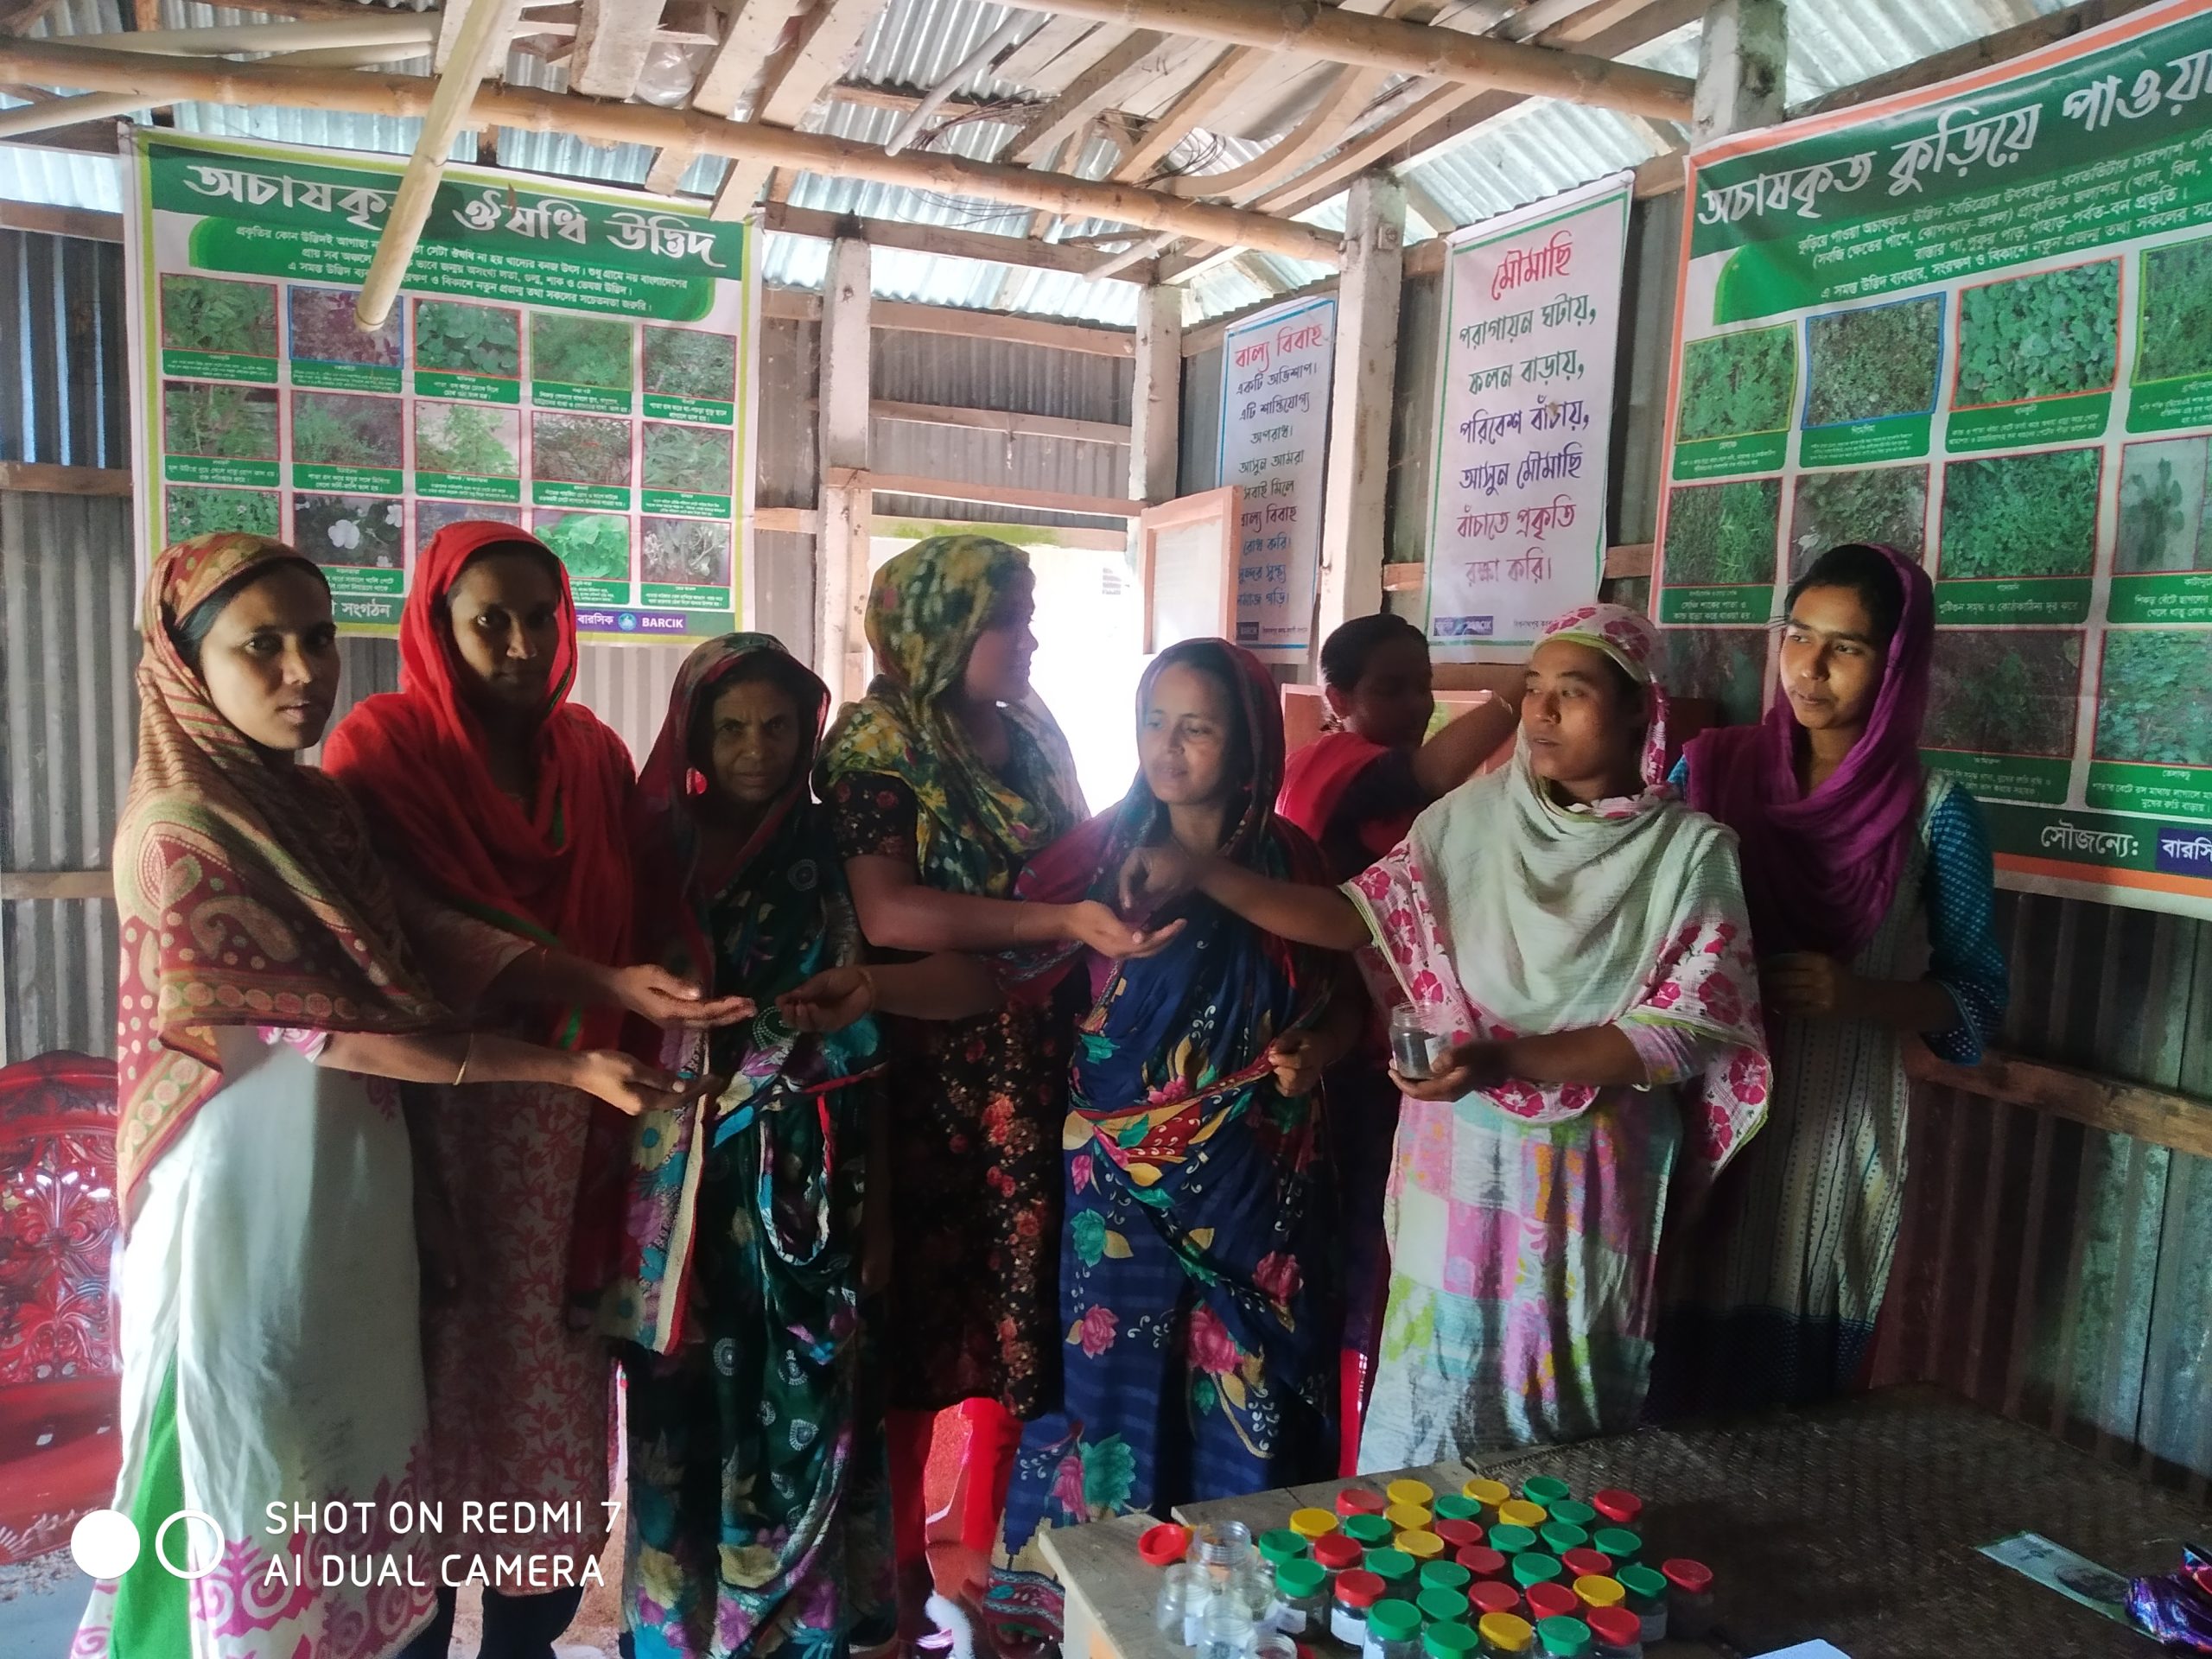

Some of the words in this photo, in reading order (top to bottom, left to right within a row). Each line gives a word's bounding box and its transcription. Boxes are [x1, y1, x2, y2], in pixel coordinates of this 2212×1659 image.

[1697, 150, 1878, 225] অচাষকৃত
[1887, 105, 2044, 197] কুড়িয়ে
[183, 165, 432, 232] অচাষকৃ
[603, 212, 727, 268] উদ্ভিদ
[1491, 230, 1573, 301] মৌমাছি
[1459, 309, 1534, 350] পরাগায়ন
[1235, 341, 1270, 373] বাল্য
[1276, 323, 1323, 357] বিবাহ
[1236, 373, 1263, 395] একটি
[1468, 365, 1513, 395] ফলন
[1239, 402, 1257, 421] এটি
[1459, 409, 1522, 445] পরিবেশ
[1238, 457, 1268, 476] আসুন
[1271, 449, 1305, 467] আমরা
[1459, 461, 1510, 496] আসুন
[1516, 442, 1583, 489] মৌমাছি
[1271, 477, 1295, 497] মিলে
[1266, 503, 1298, 524] বিবাহ
[1457, 505, 1511, 541] বাঁচাতে
[1516, 494, 1577, 541] প্রকৃতি
[340, 598, 392, 618] সংগঠন
[641, 617, 684, 628] BARCIK
[2160, 836, 2212, 862] বারসি
